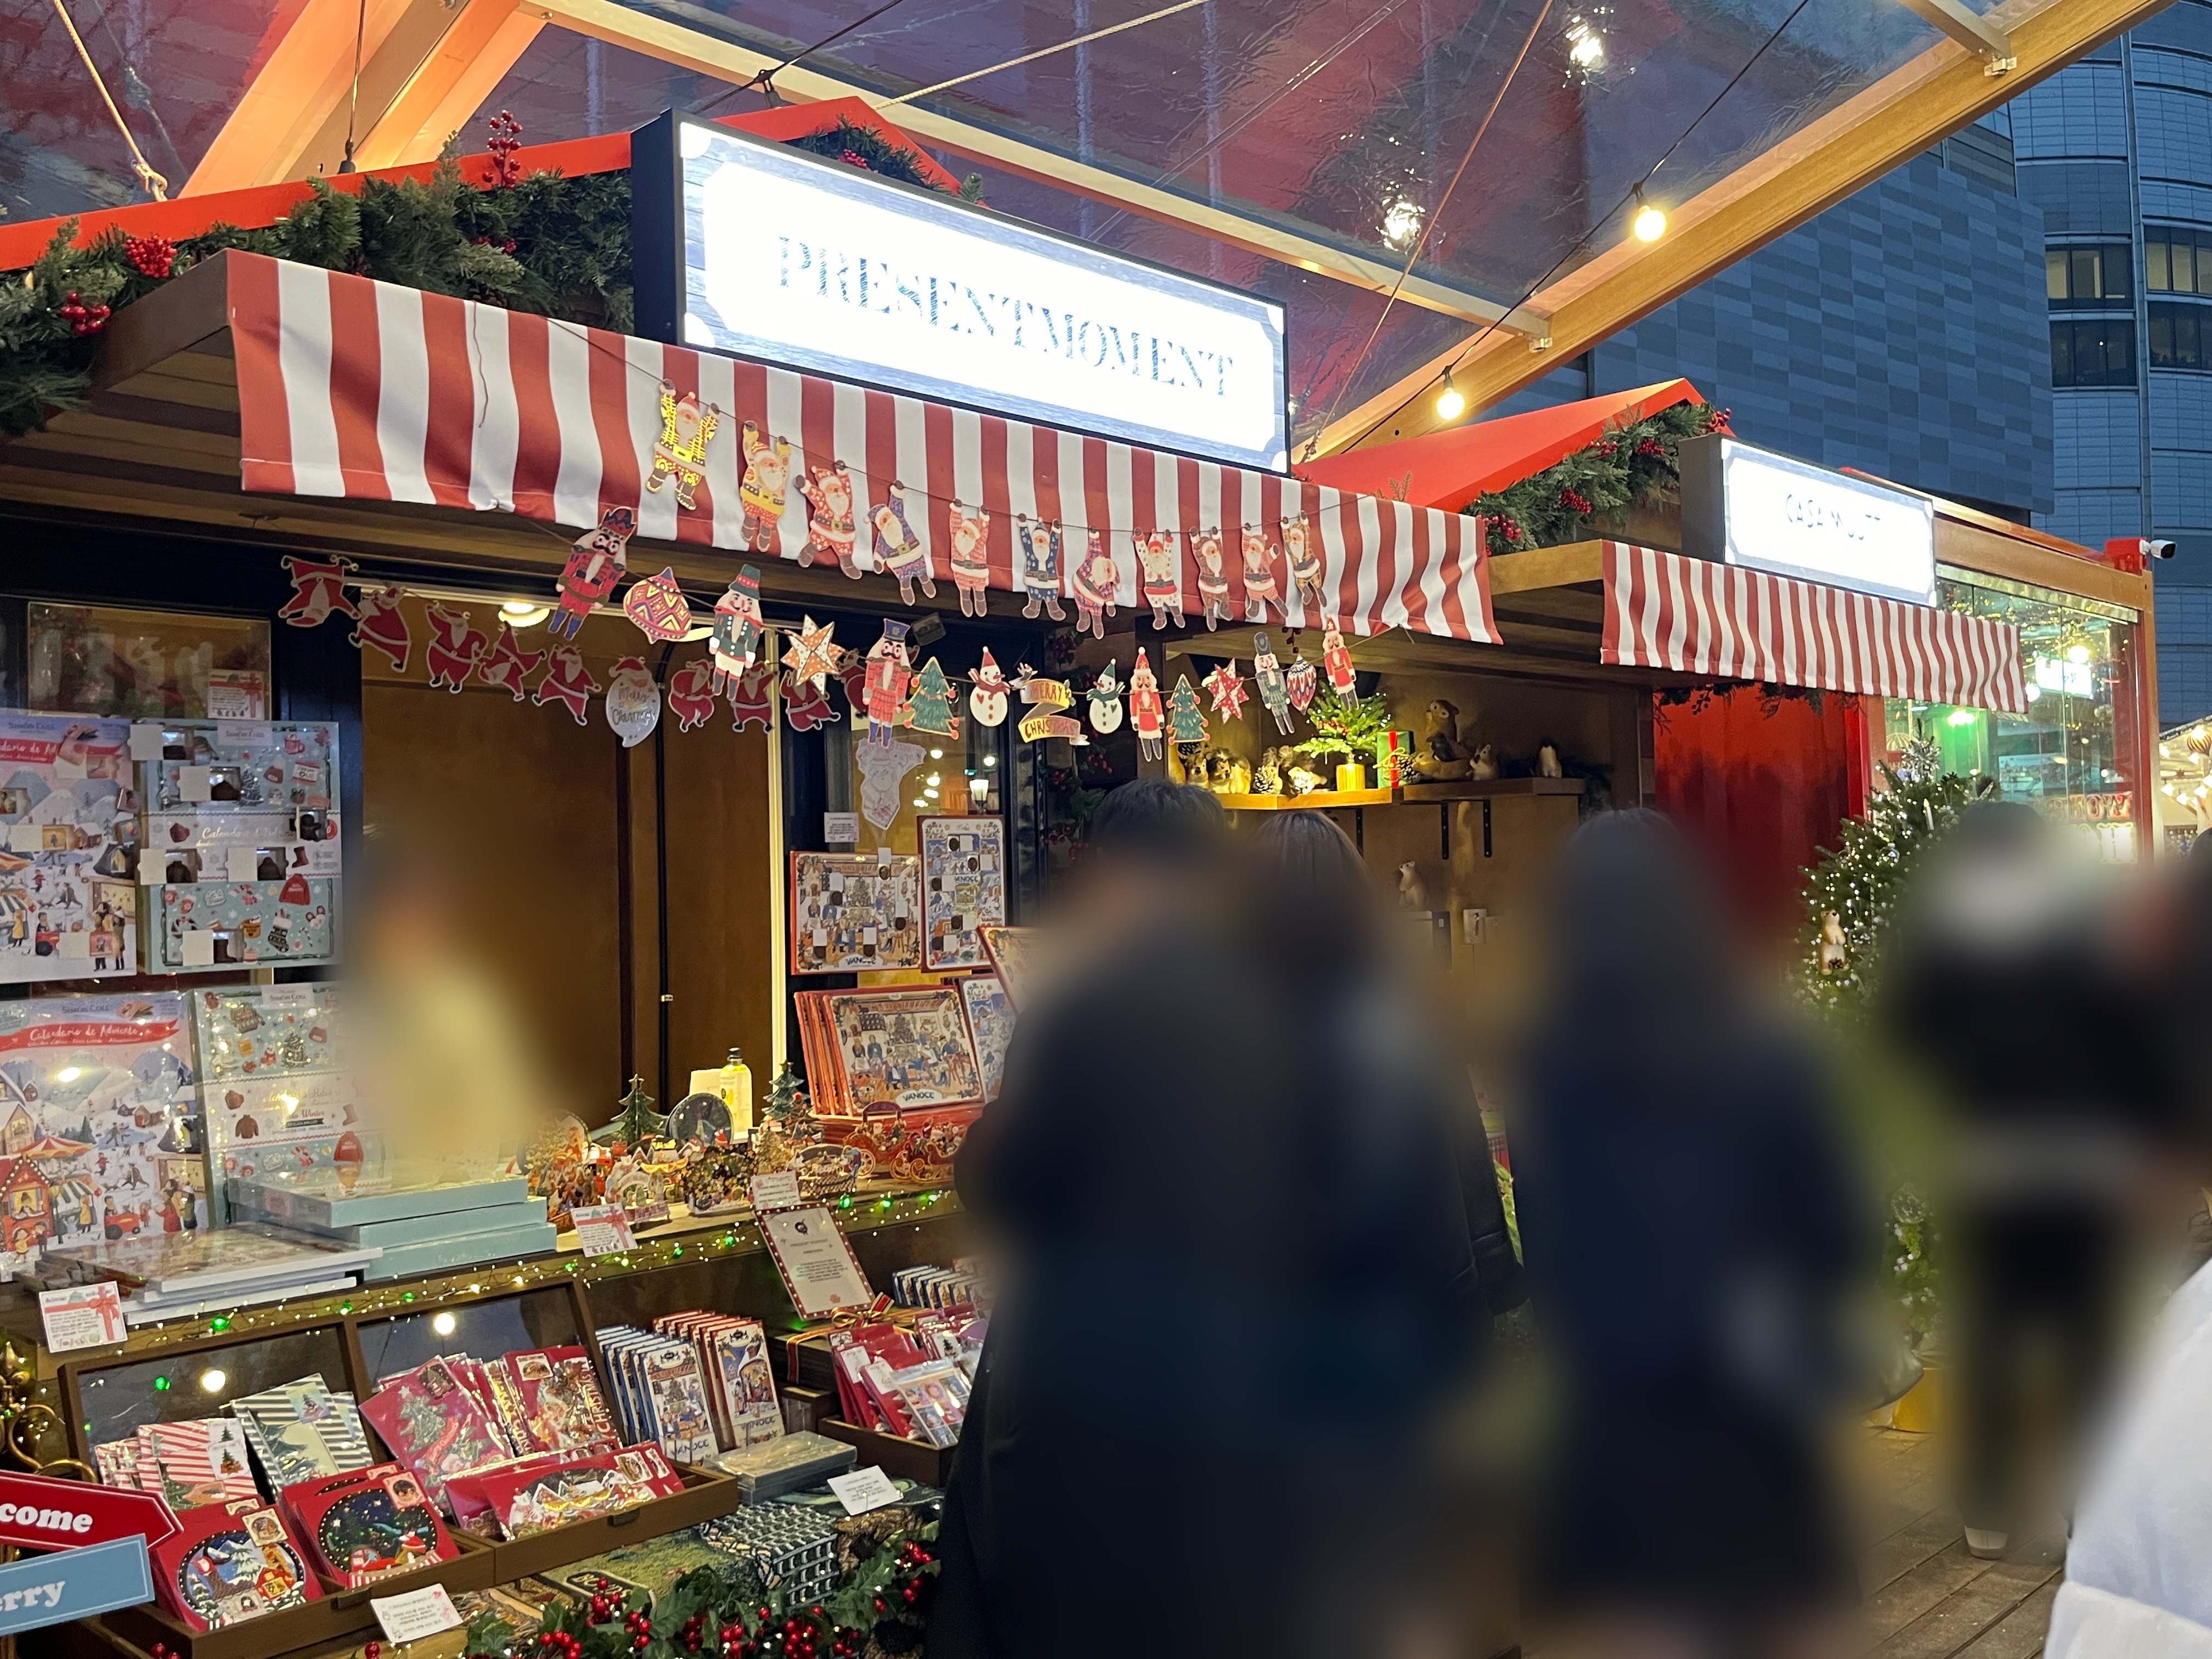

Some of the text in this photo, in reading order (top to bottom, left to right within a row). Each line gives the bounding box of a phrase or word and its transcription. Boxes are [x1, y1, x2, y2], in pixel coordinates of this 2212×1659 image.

[1031, 682, 1063, 703] MERRY
[1025, 719, 1076, 738] CHRISTMAS
[0, 1581, 66, 1612] rry
